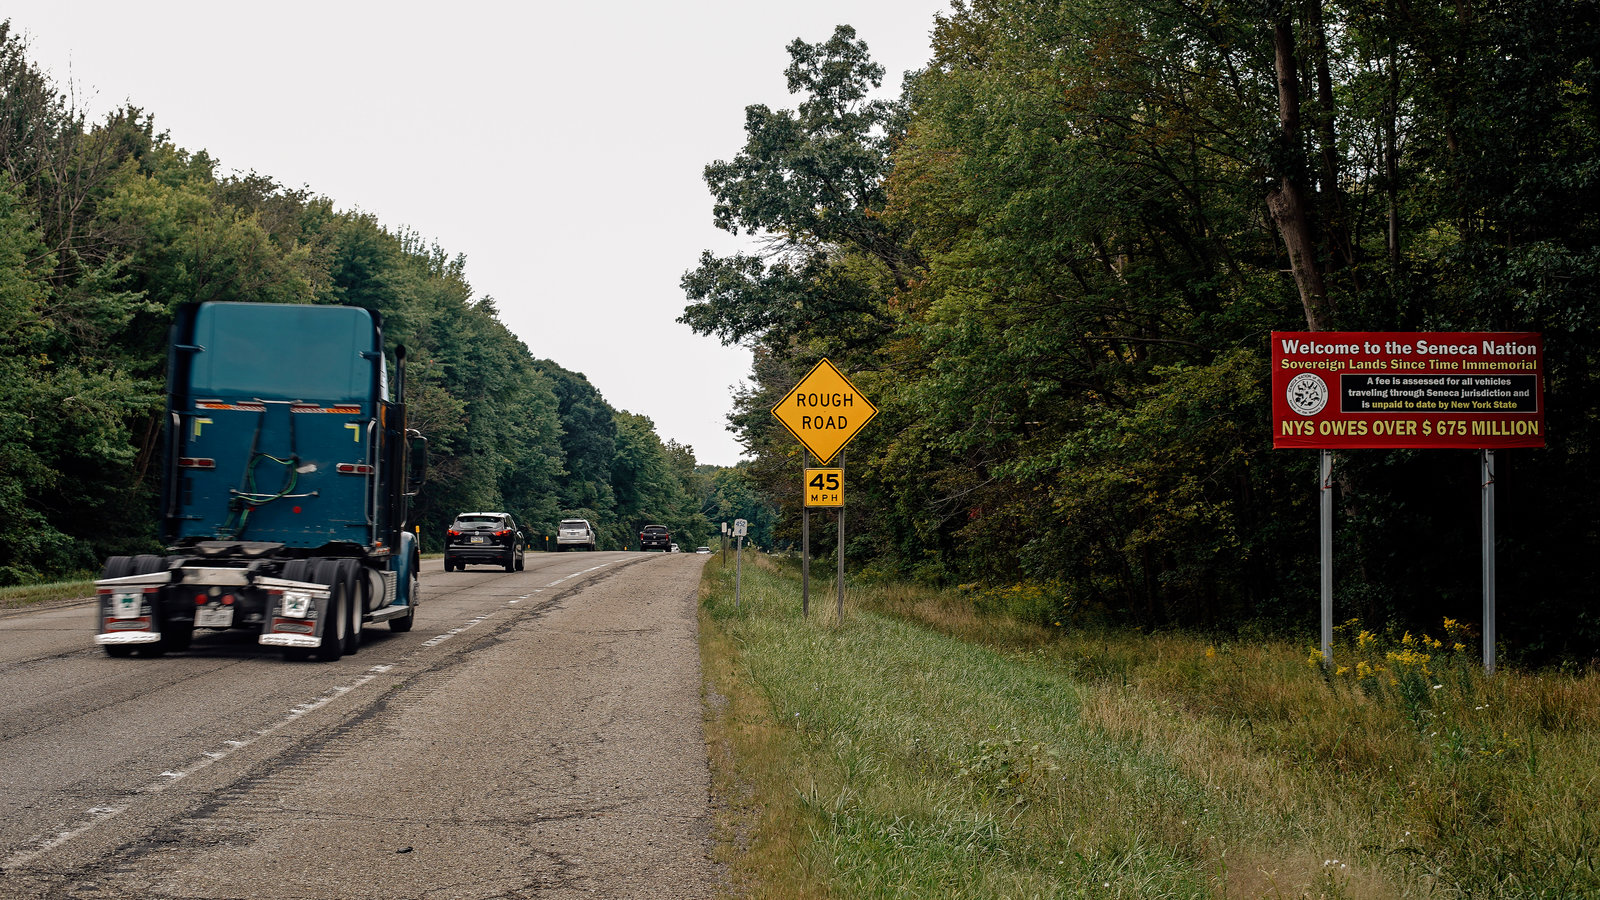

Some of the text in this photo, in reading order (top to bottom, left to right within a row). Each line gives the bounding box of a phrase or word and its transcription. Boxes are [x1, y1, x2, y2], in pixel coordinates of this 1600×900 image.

[1281, 339, 1537, 355] Welcome to the Seneca Nation
[1281, 358, 1537, 372] Sovereign Lands Since Time Immemorial
[1366, 377, 1512, 386] A fee is assessed for all vehicles
[797, 393, 853, 407] ROUGH
[1348, 388, 1530, 398] traveling through Seneca jurisdiction and
[1361, 400, 1518, 410] is unpaid to date by New York State
[802, 415, 848, 430] ROAD
[1281, 419, 1539, 436] NYS OWES OVER $ 675 MILLION
[809, 473, 840, 491] 45
[811, 494, 838, 502] MPH
